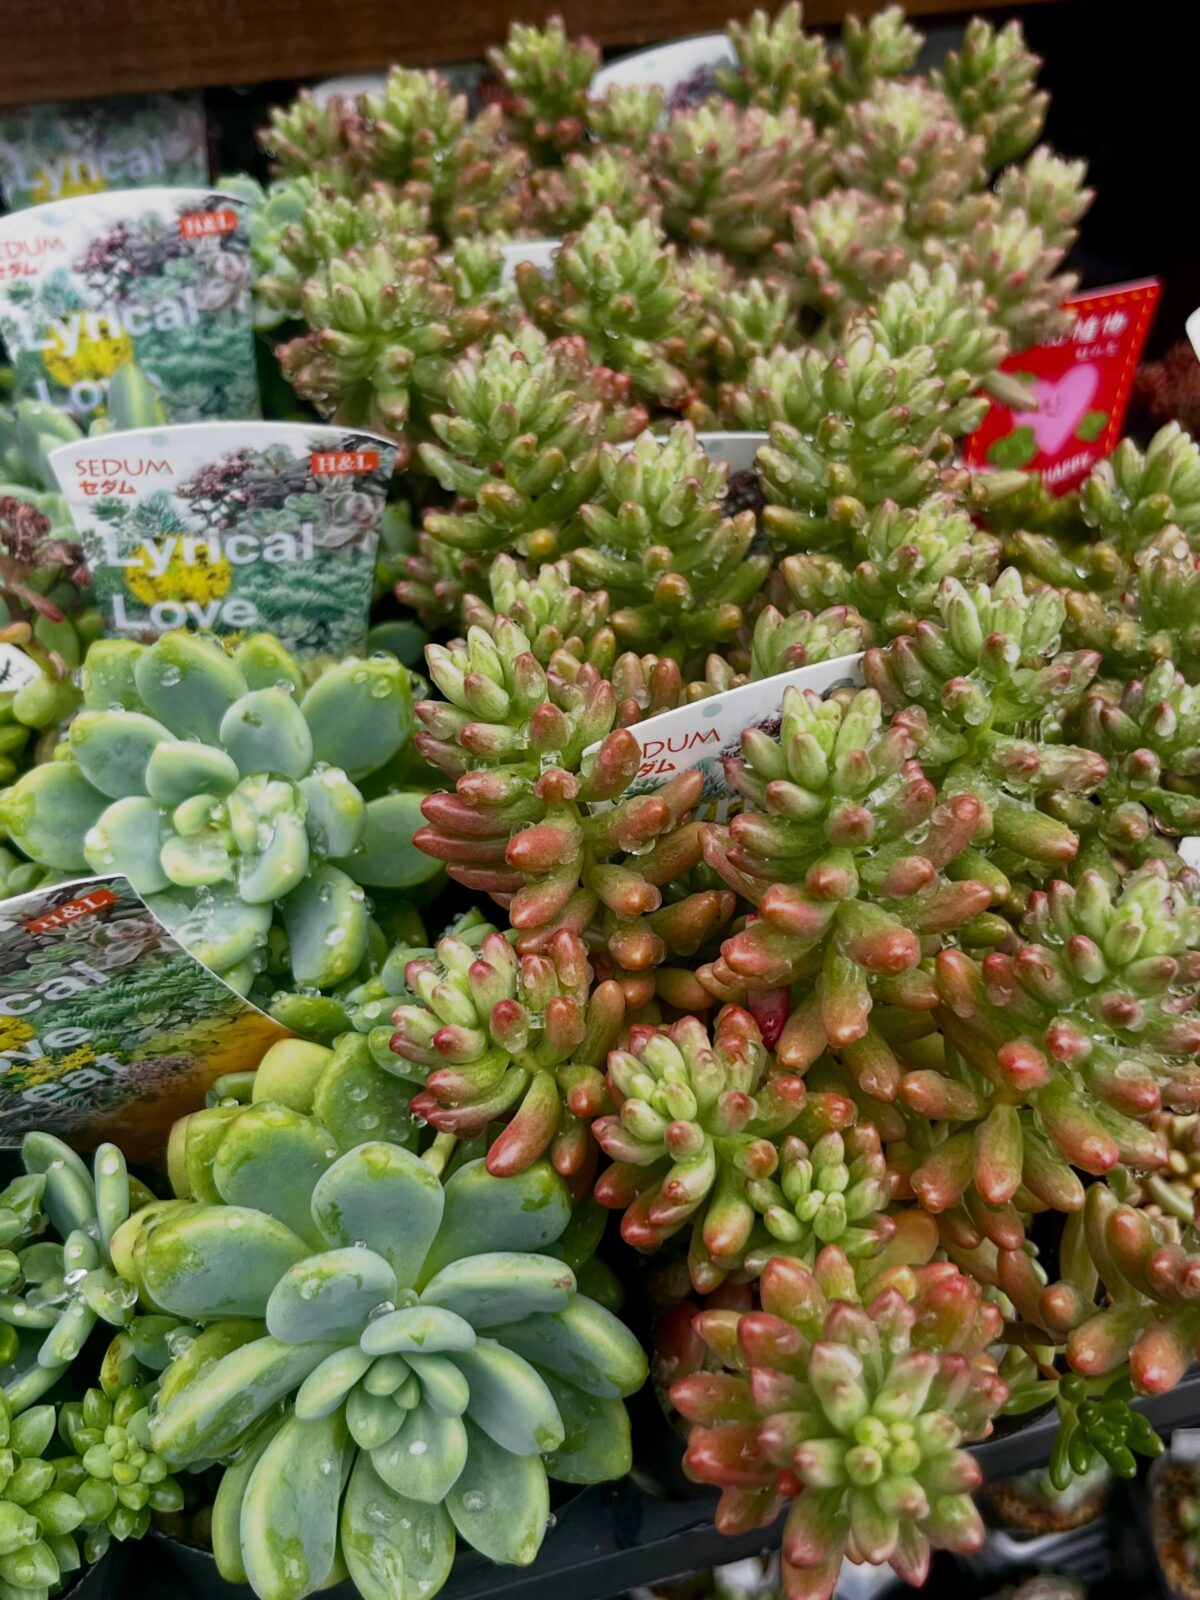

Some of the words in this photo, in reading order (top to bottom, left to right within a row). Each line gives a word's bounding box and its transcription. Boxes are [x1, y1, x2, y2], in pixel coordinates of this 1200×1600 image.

[22, 286, 200, 357] Lyrical
[75, 457, 174, 478] SEDUM
[316, 455, 373, 473] H&L
[1042, 450, 1092, 484] HAPPY
[79, 479, 137, 496] セダム
[104, 523, 315, 577] Lyrical
[112, 594, 259, 630] Love
[642, 728, 721, 759] DUM
